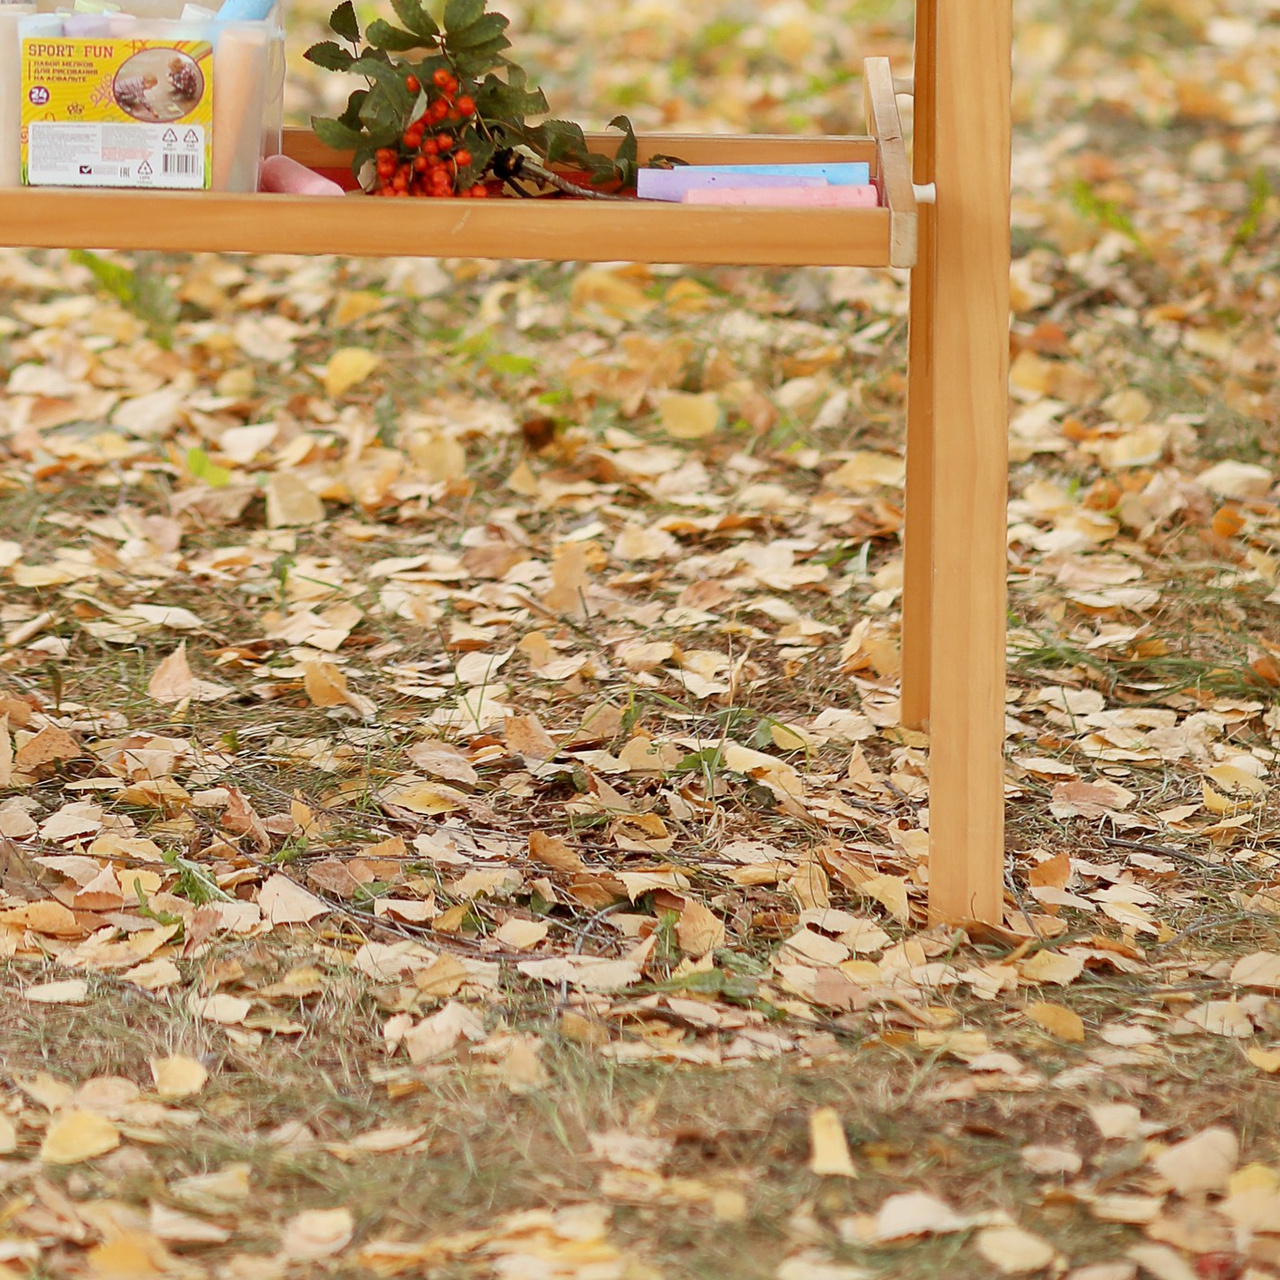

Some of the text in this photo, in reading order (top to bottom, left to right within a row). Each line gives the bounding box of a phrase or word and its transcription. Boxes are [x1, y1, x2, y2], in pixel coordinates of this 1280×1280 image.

[28, 43, 113, 58] SPORT FUN
[31, 87, 48, 99] 24
